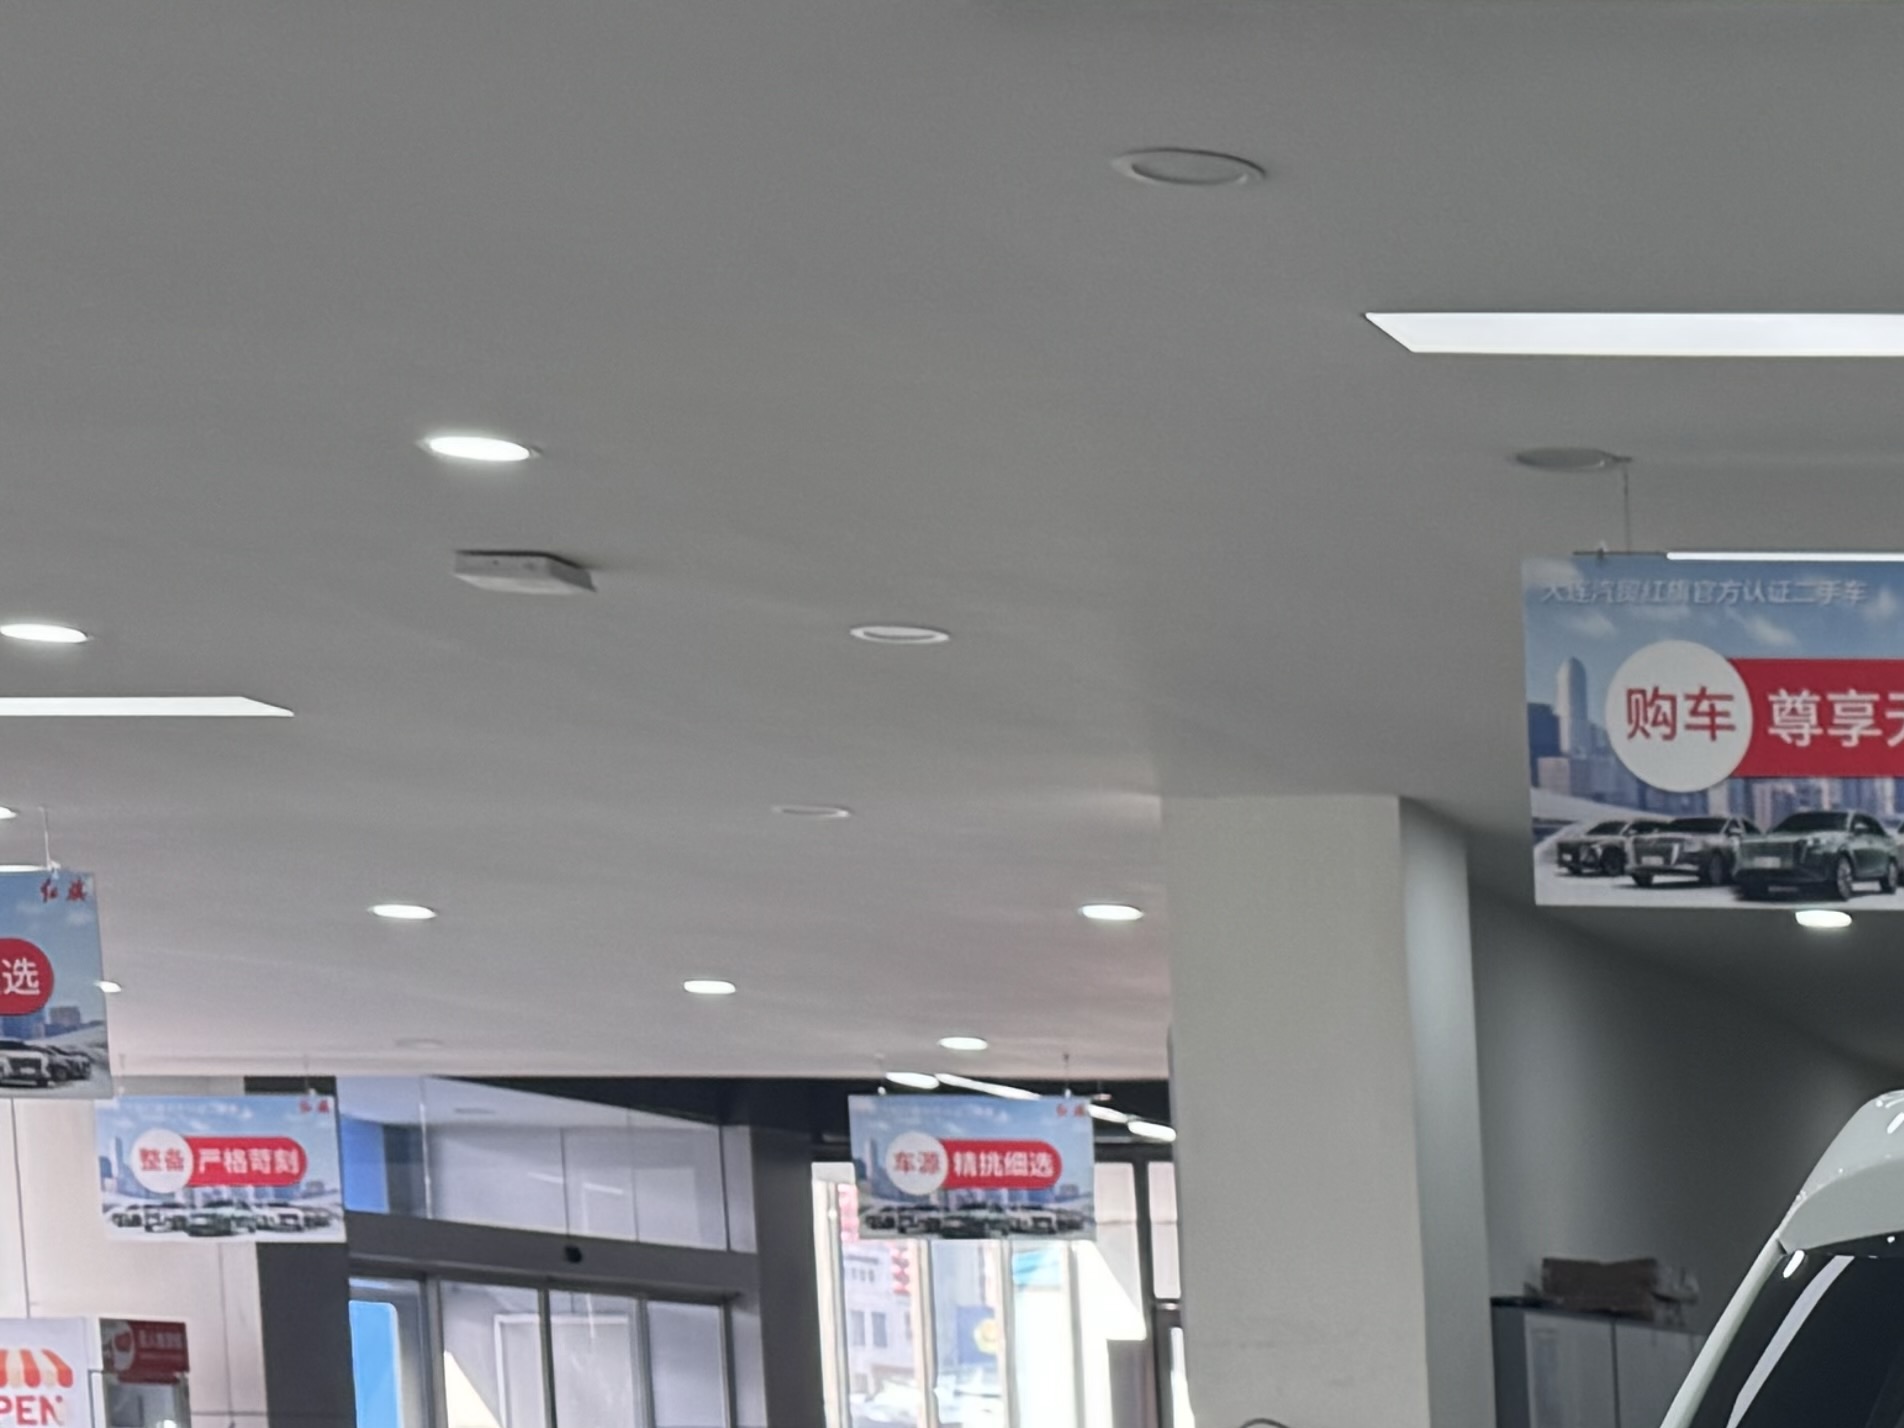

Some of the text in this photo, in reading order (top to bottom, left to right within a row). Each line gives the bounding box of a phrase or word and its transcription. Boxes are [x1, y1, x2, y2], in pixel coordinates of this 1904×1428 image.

[1625, 687, 1737, 742] 购车
[953, 1151, 1054, 1178] 精挑细选
